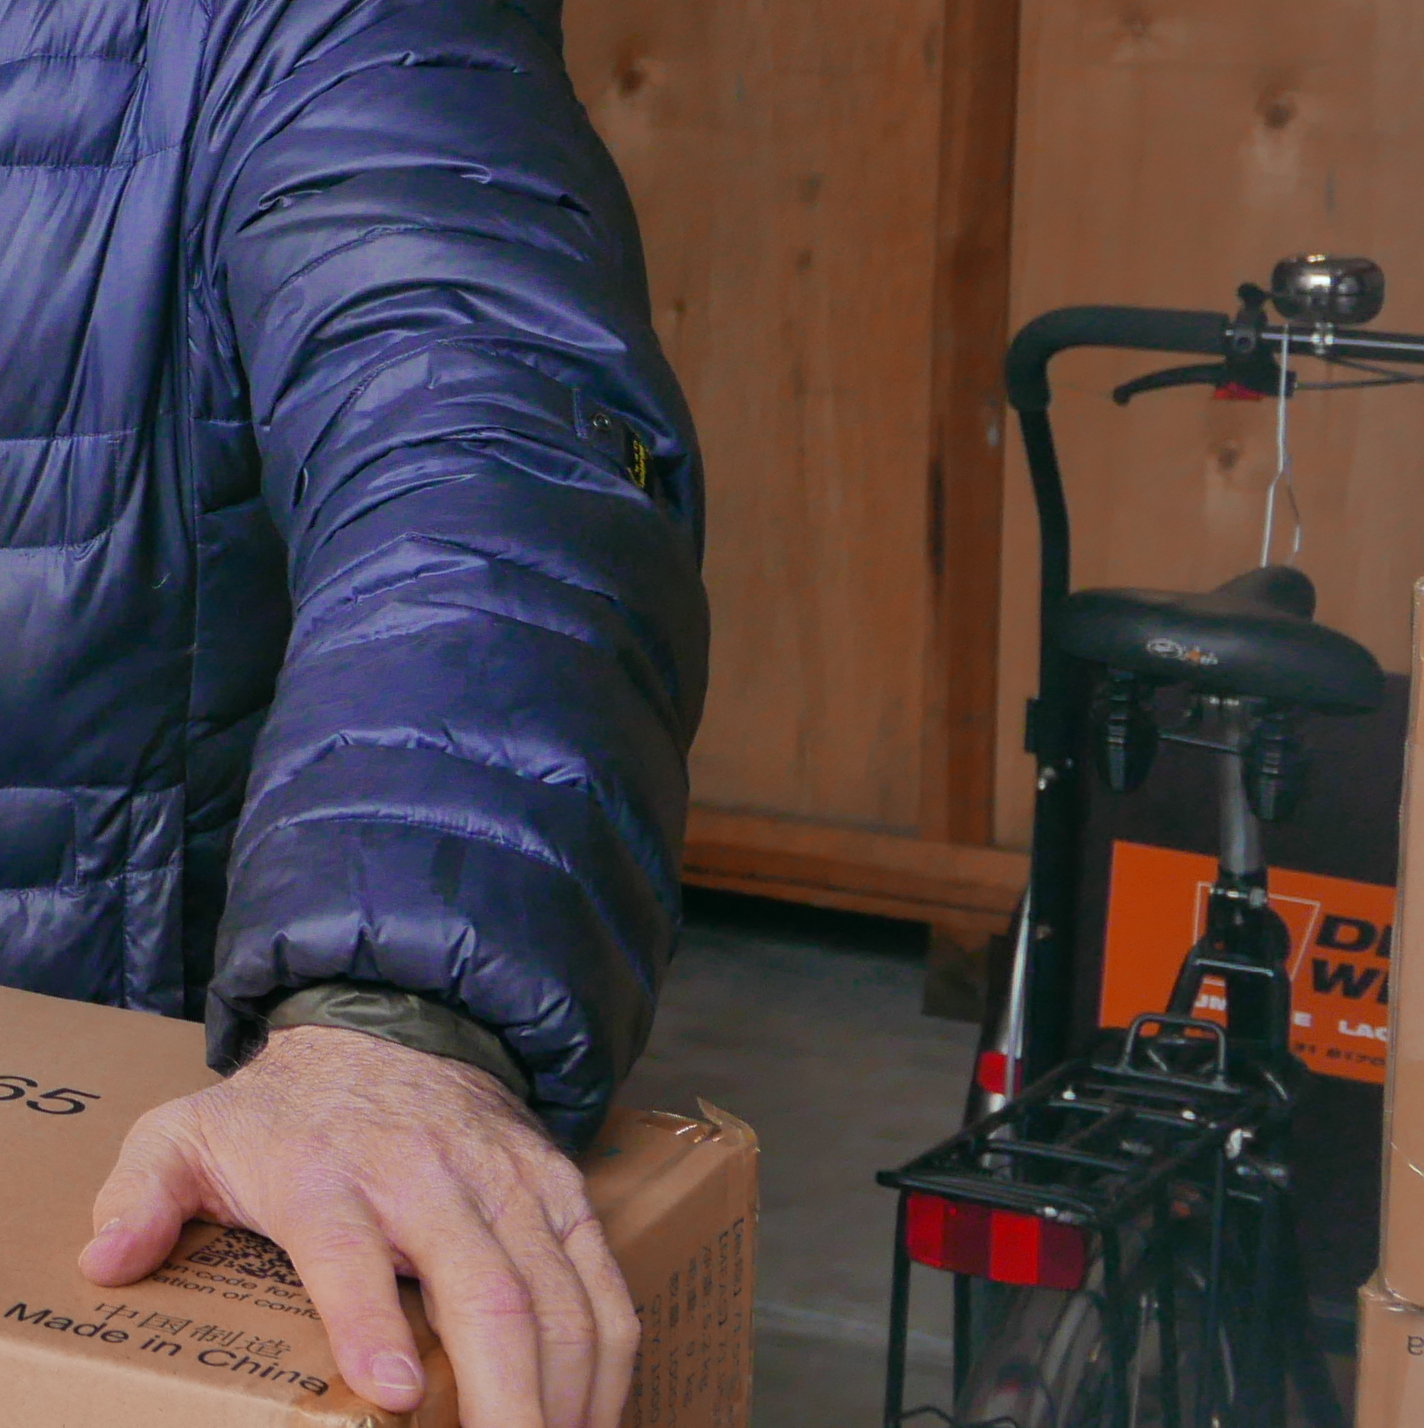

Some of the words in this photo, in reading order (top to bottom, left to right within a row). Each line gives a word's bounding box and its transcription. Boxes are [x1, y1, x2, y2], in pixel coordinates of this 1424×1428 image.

[195, 1271, 258, 1290] code
[264, 1285, 303, 1300] for
[222, 1291, 254, 1303] of
[4, 1302, 130, 1344] Made
[140, 1335, 183, 1357] in
[197, 1348, 330, 1397] China
[94, 1303, 292, 1360] 中国制造
